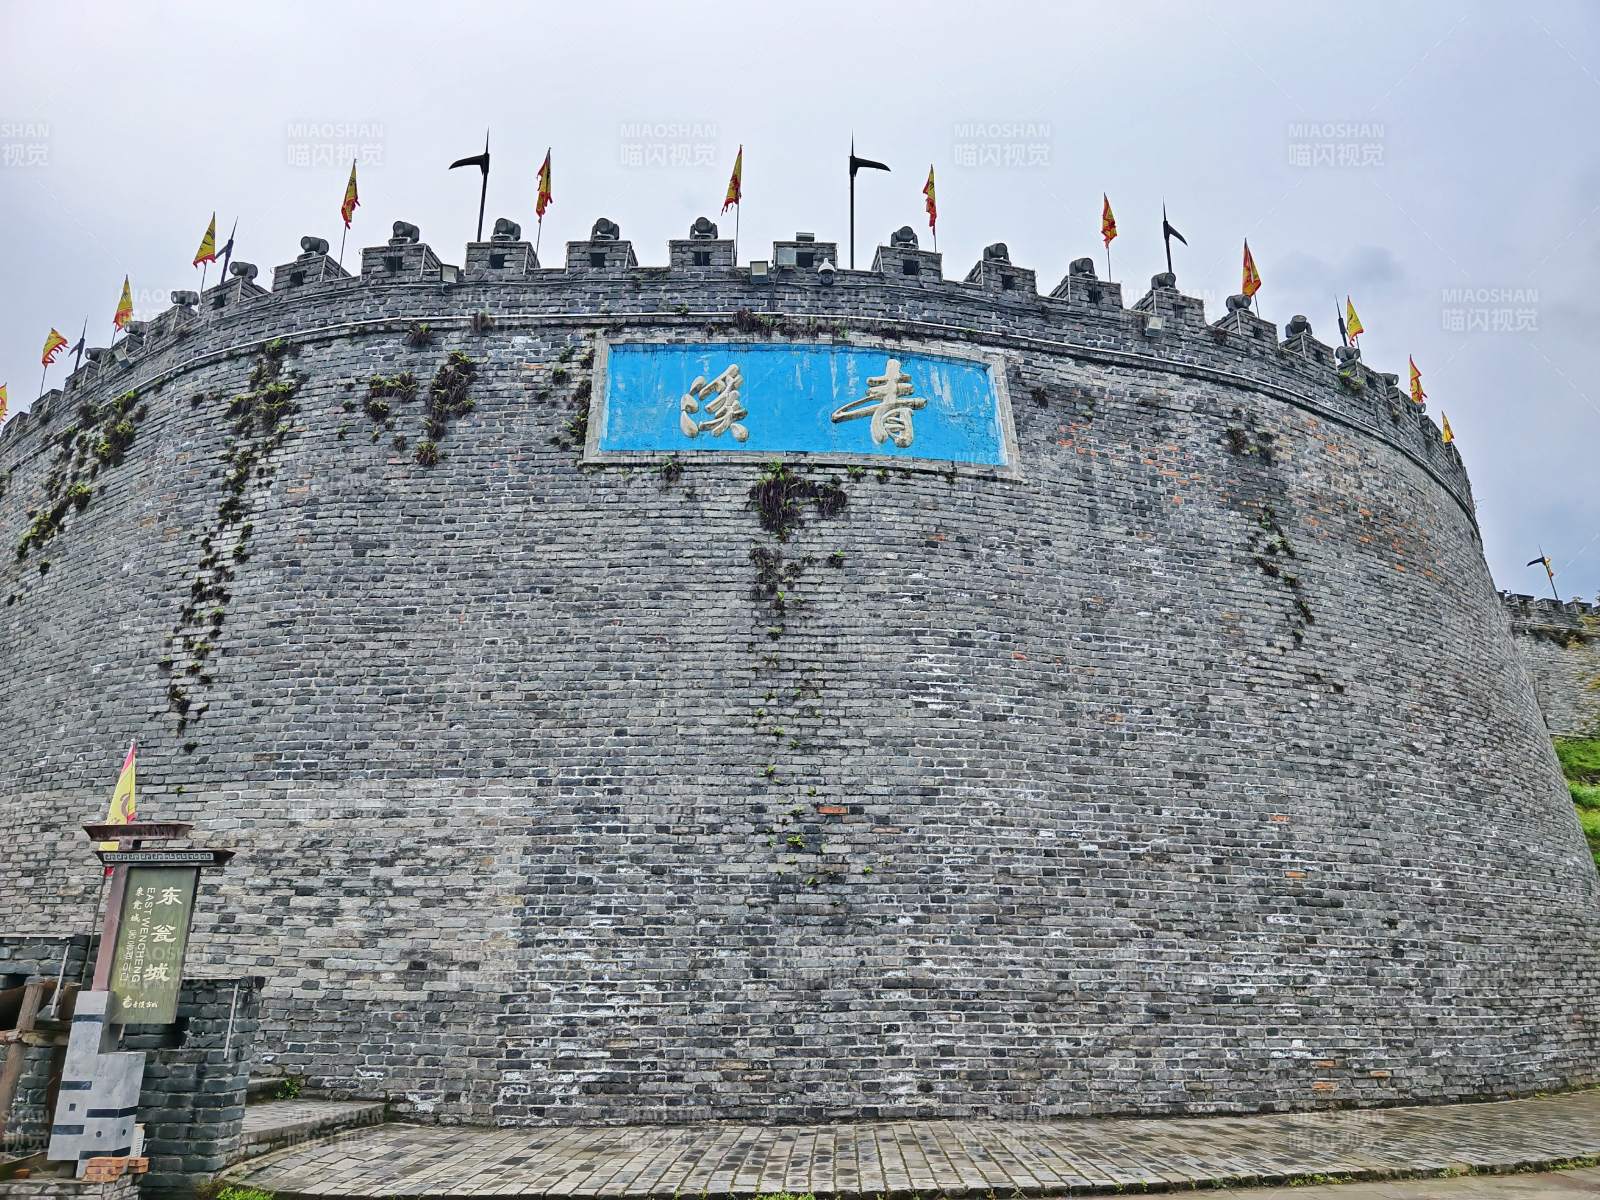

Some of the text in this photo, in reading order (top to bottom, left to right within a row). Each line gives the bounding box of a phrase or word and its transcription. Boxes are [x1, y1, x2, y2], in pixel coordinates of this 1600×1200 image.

[131, 887, 156, 983] EAST WENCHENG
[143, 886, 183, 982] 东瓮城
